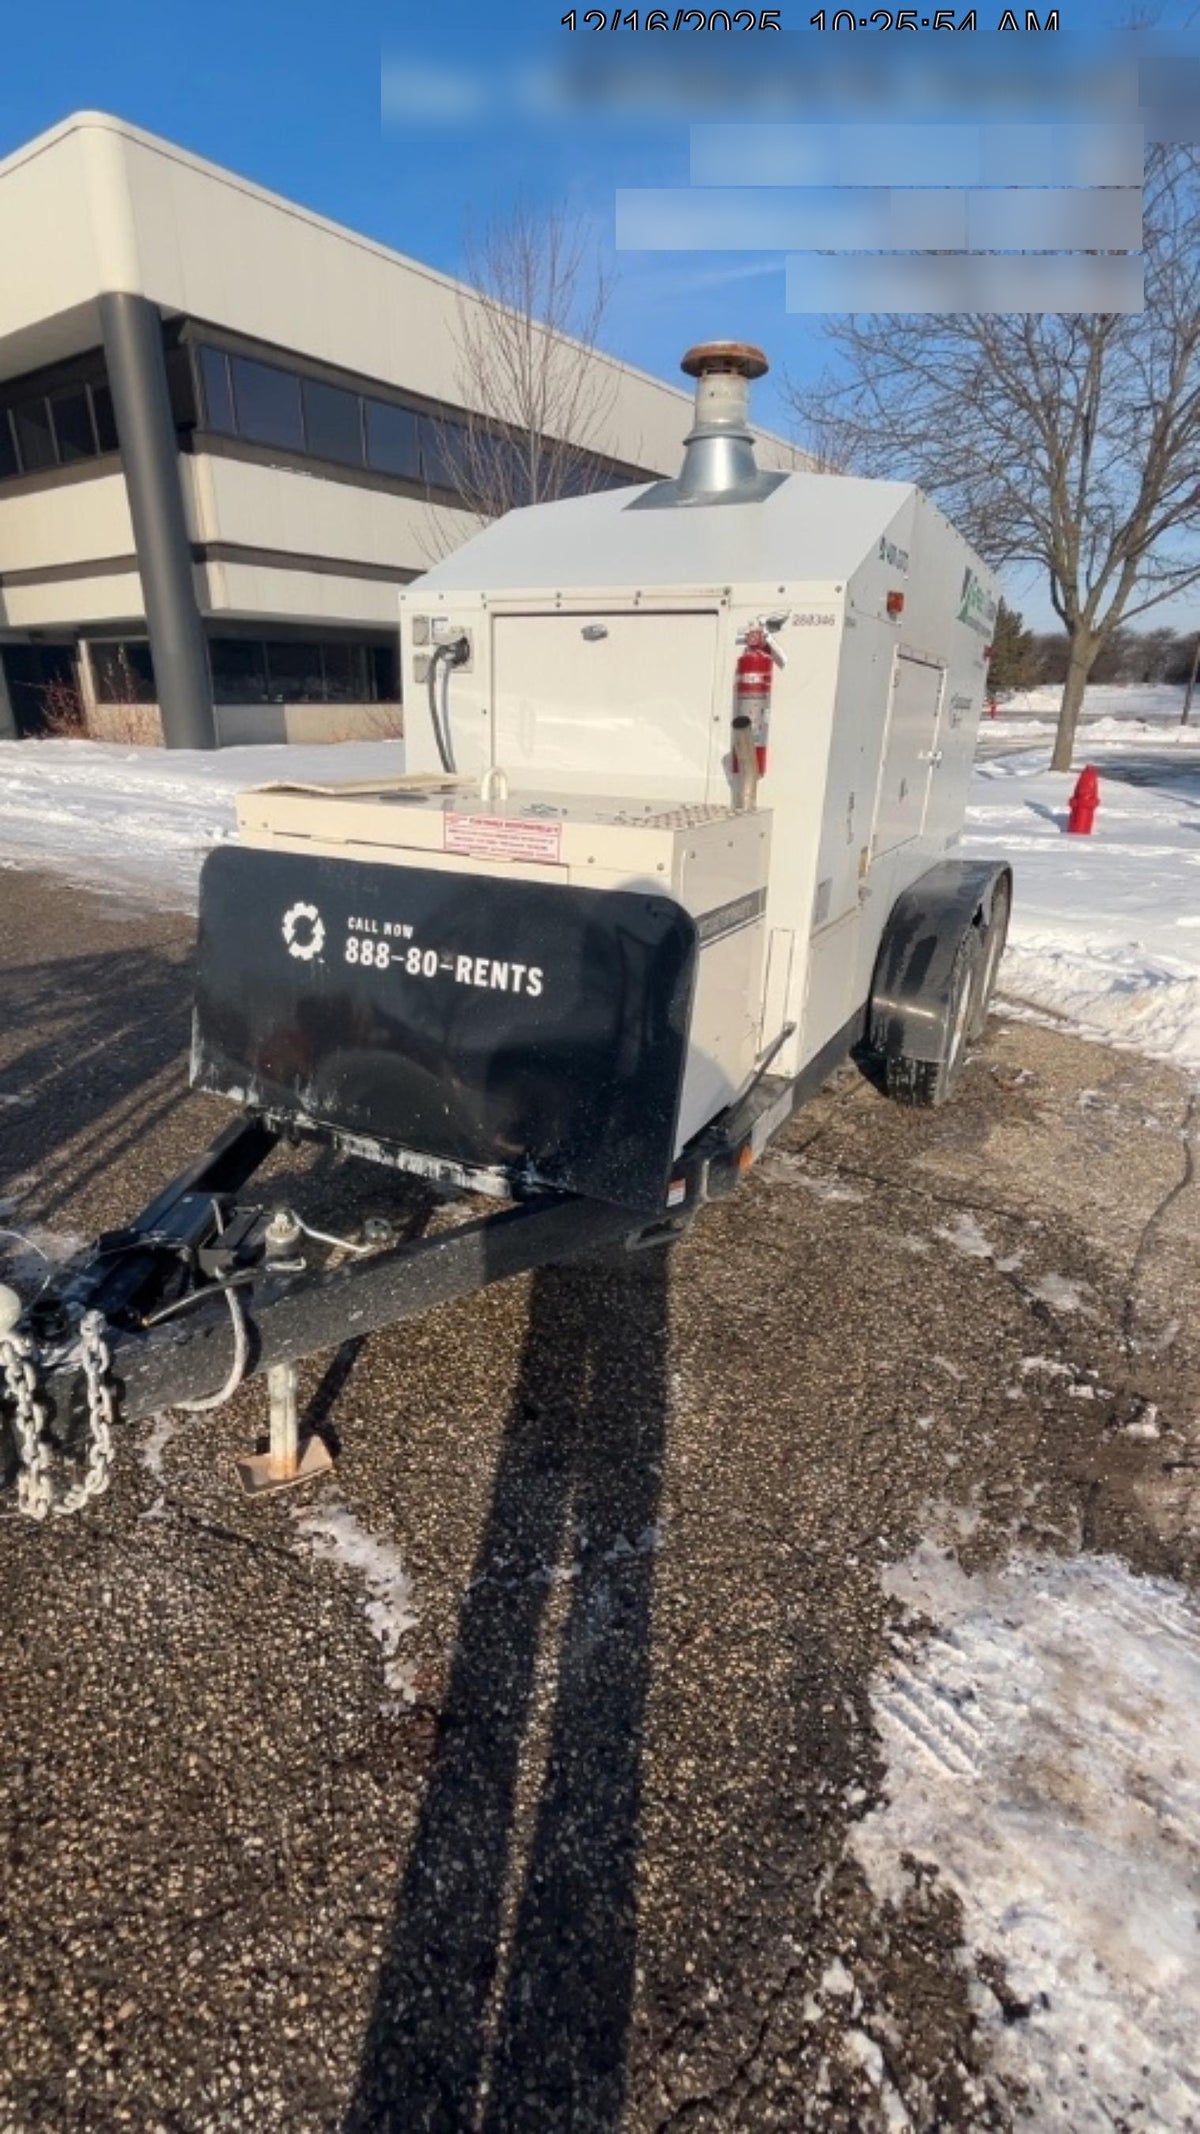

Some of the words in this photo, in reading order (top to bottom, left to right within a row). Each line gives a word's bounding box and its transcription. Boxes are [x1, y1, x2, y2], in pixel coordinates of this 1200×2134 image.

[347, 916, 379, 934] CALL
[384, 921, 414, 939] NOW
[345, 936, 544, 997] 888-80-RENTS
